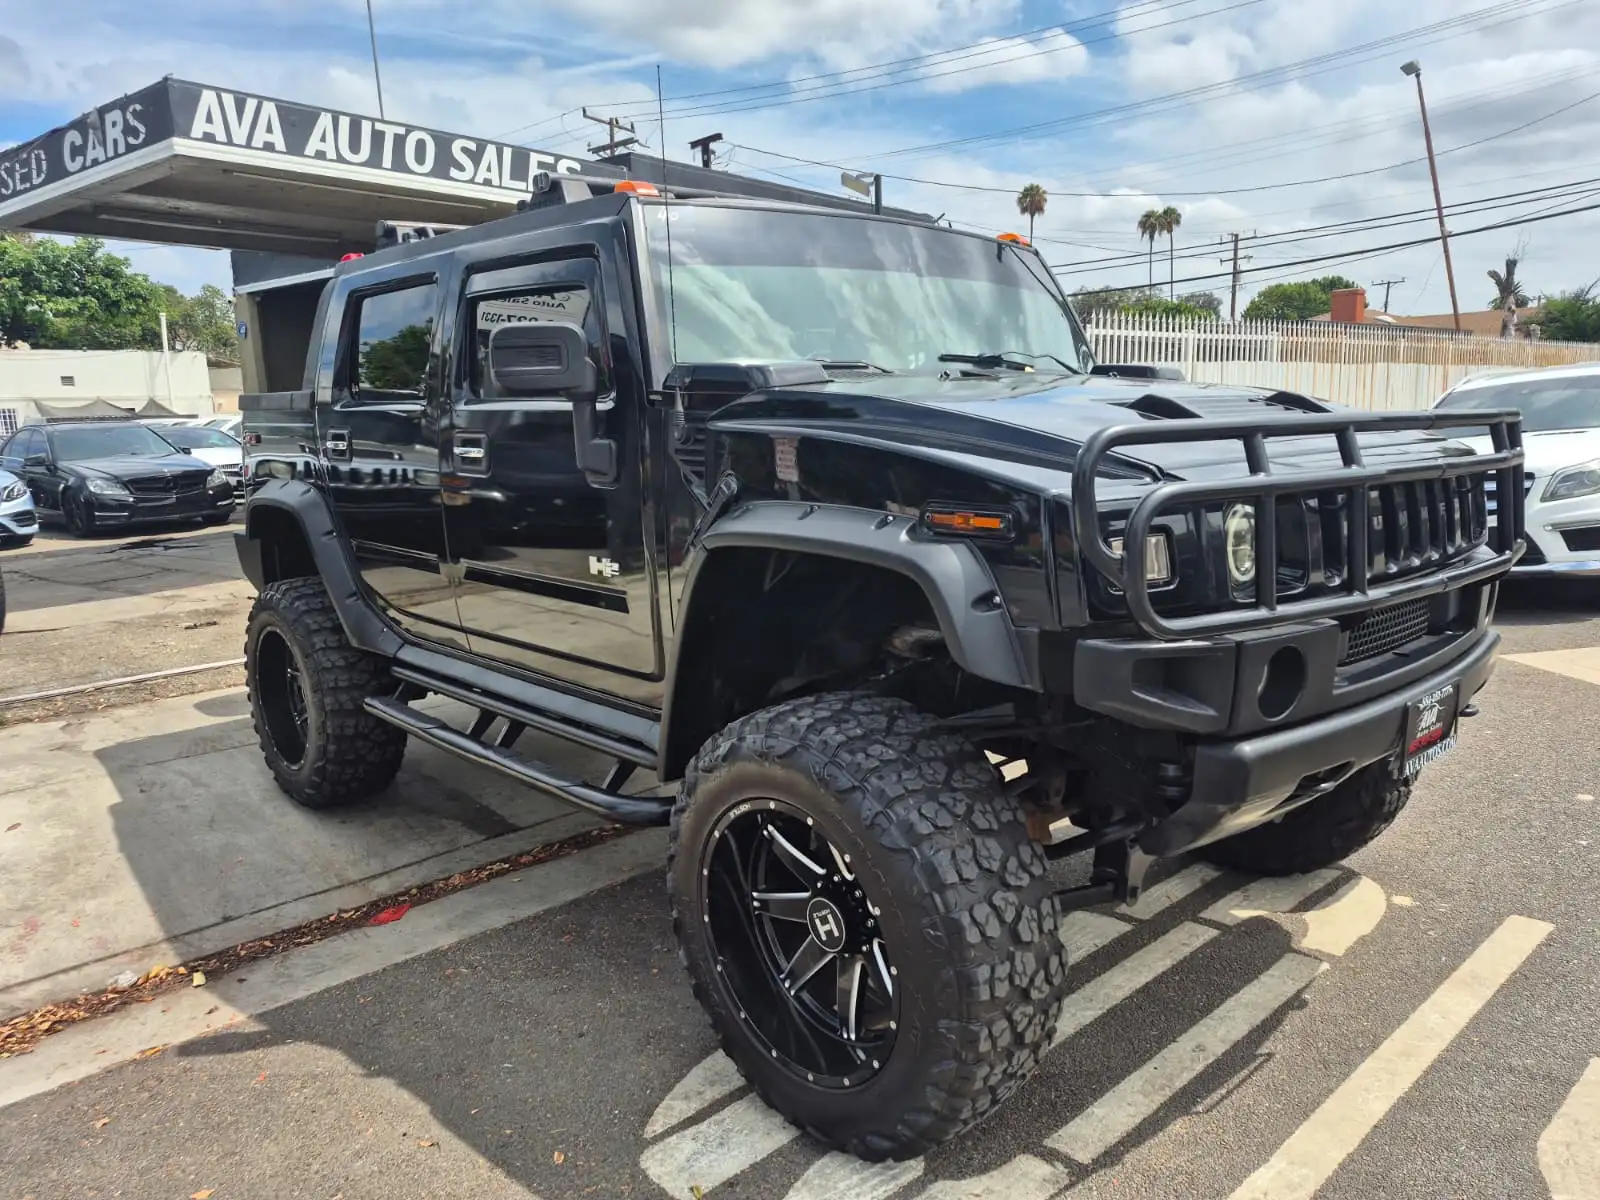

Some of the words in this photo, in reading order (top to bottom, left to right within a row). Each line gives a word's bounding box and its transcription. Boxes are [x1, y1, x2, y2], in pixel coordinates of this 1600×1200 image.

[63, 103, 146, 173] CARS
[190, 89, 287, 152] AVA
[304, 111, 435, 174] AUTO
[815, 914, 840, 941] H
